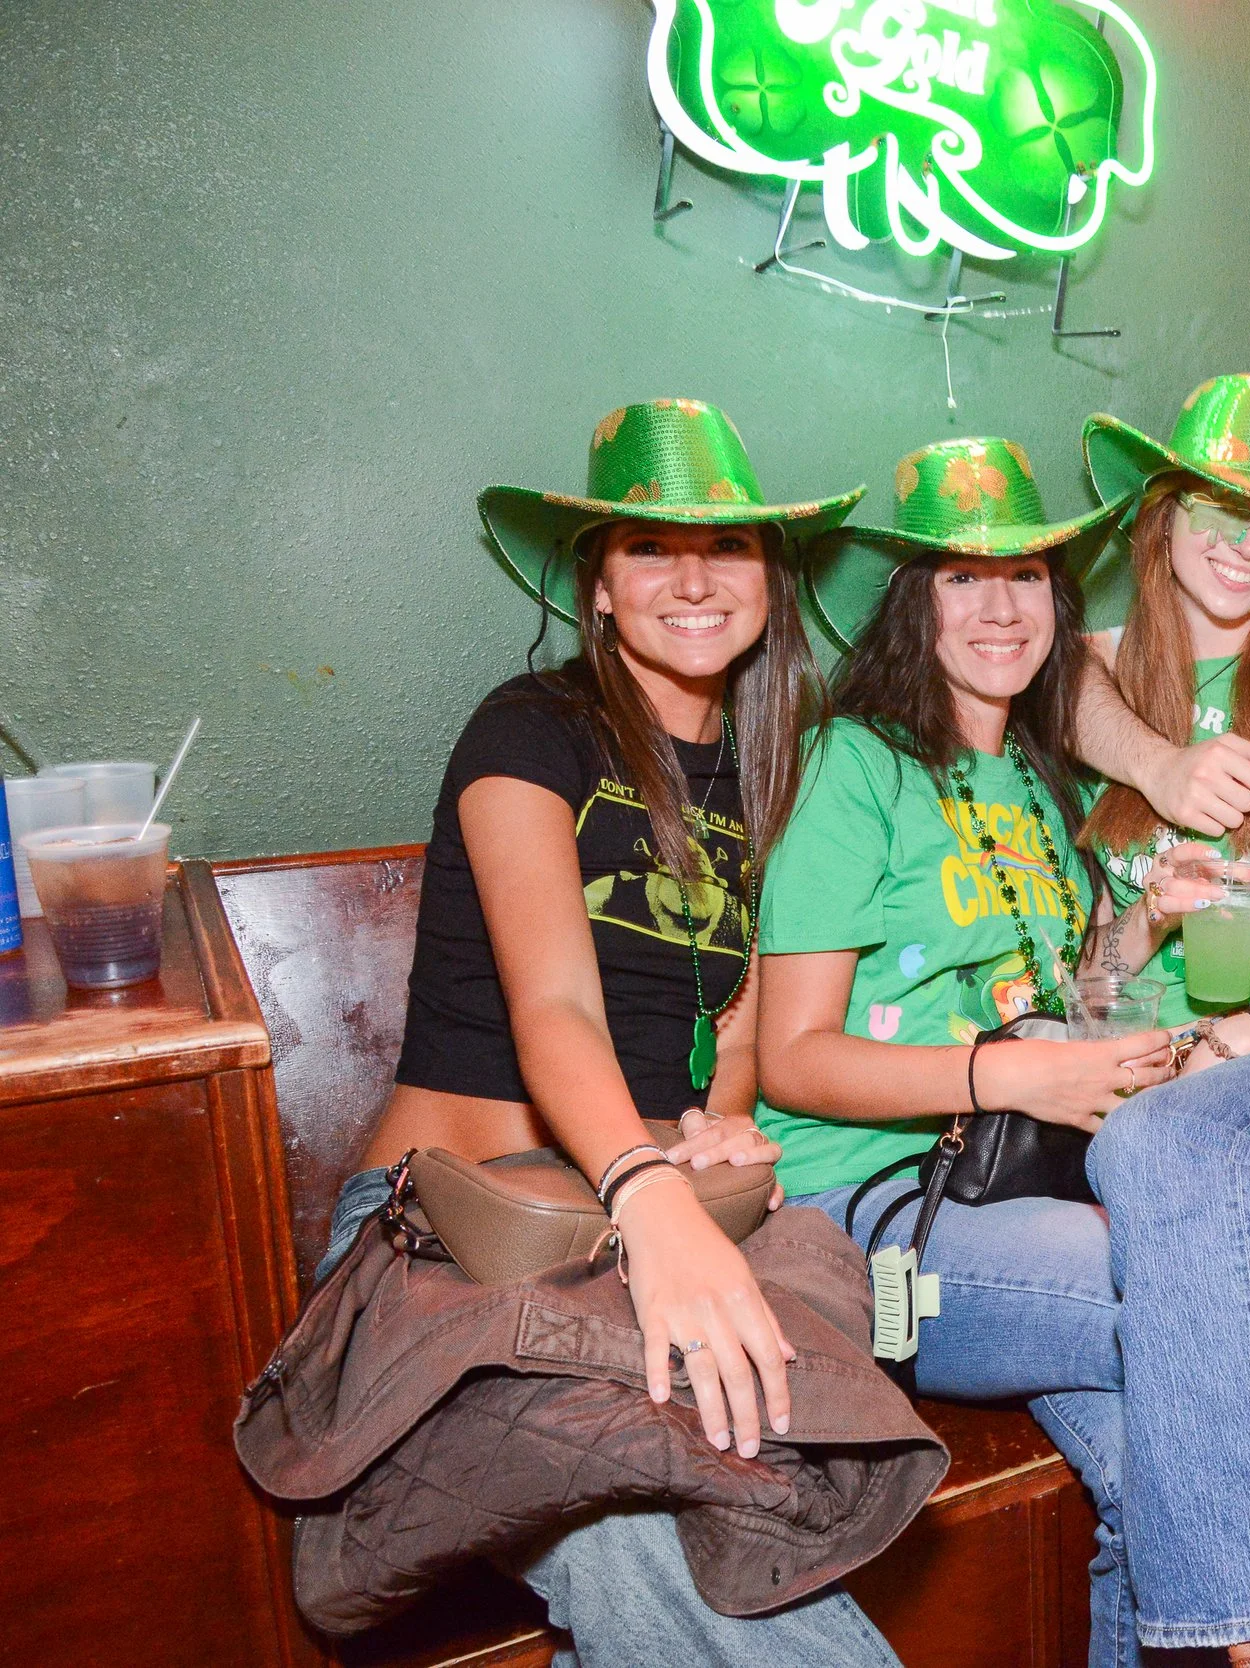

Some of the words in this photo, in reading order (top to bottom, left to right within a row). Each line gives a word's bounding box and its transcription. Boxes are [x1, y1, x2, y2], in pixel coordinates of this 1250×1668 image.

[600, 778, 635, 799] DON'T
[709, 811, 726, 827] I'M
[728, 819, 744, 833] AN
